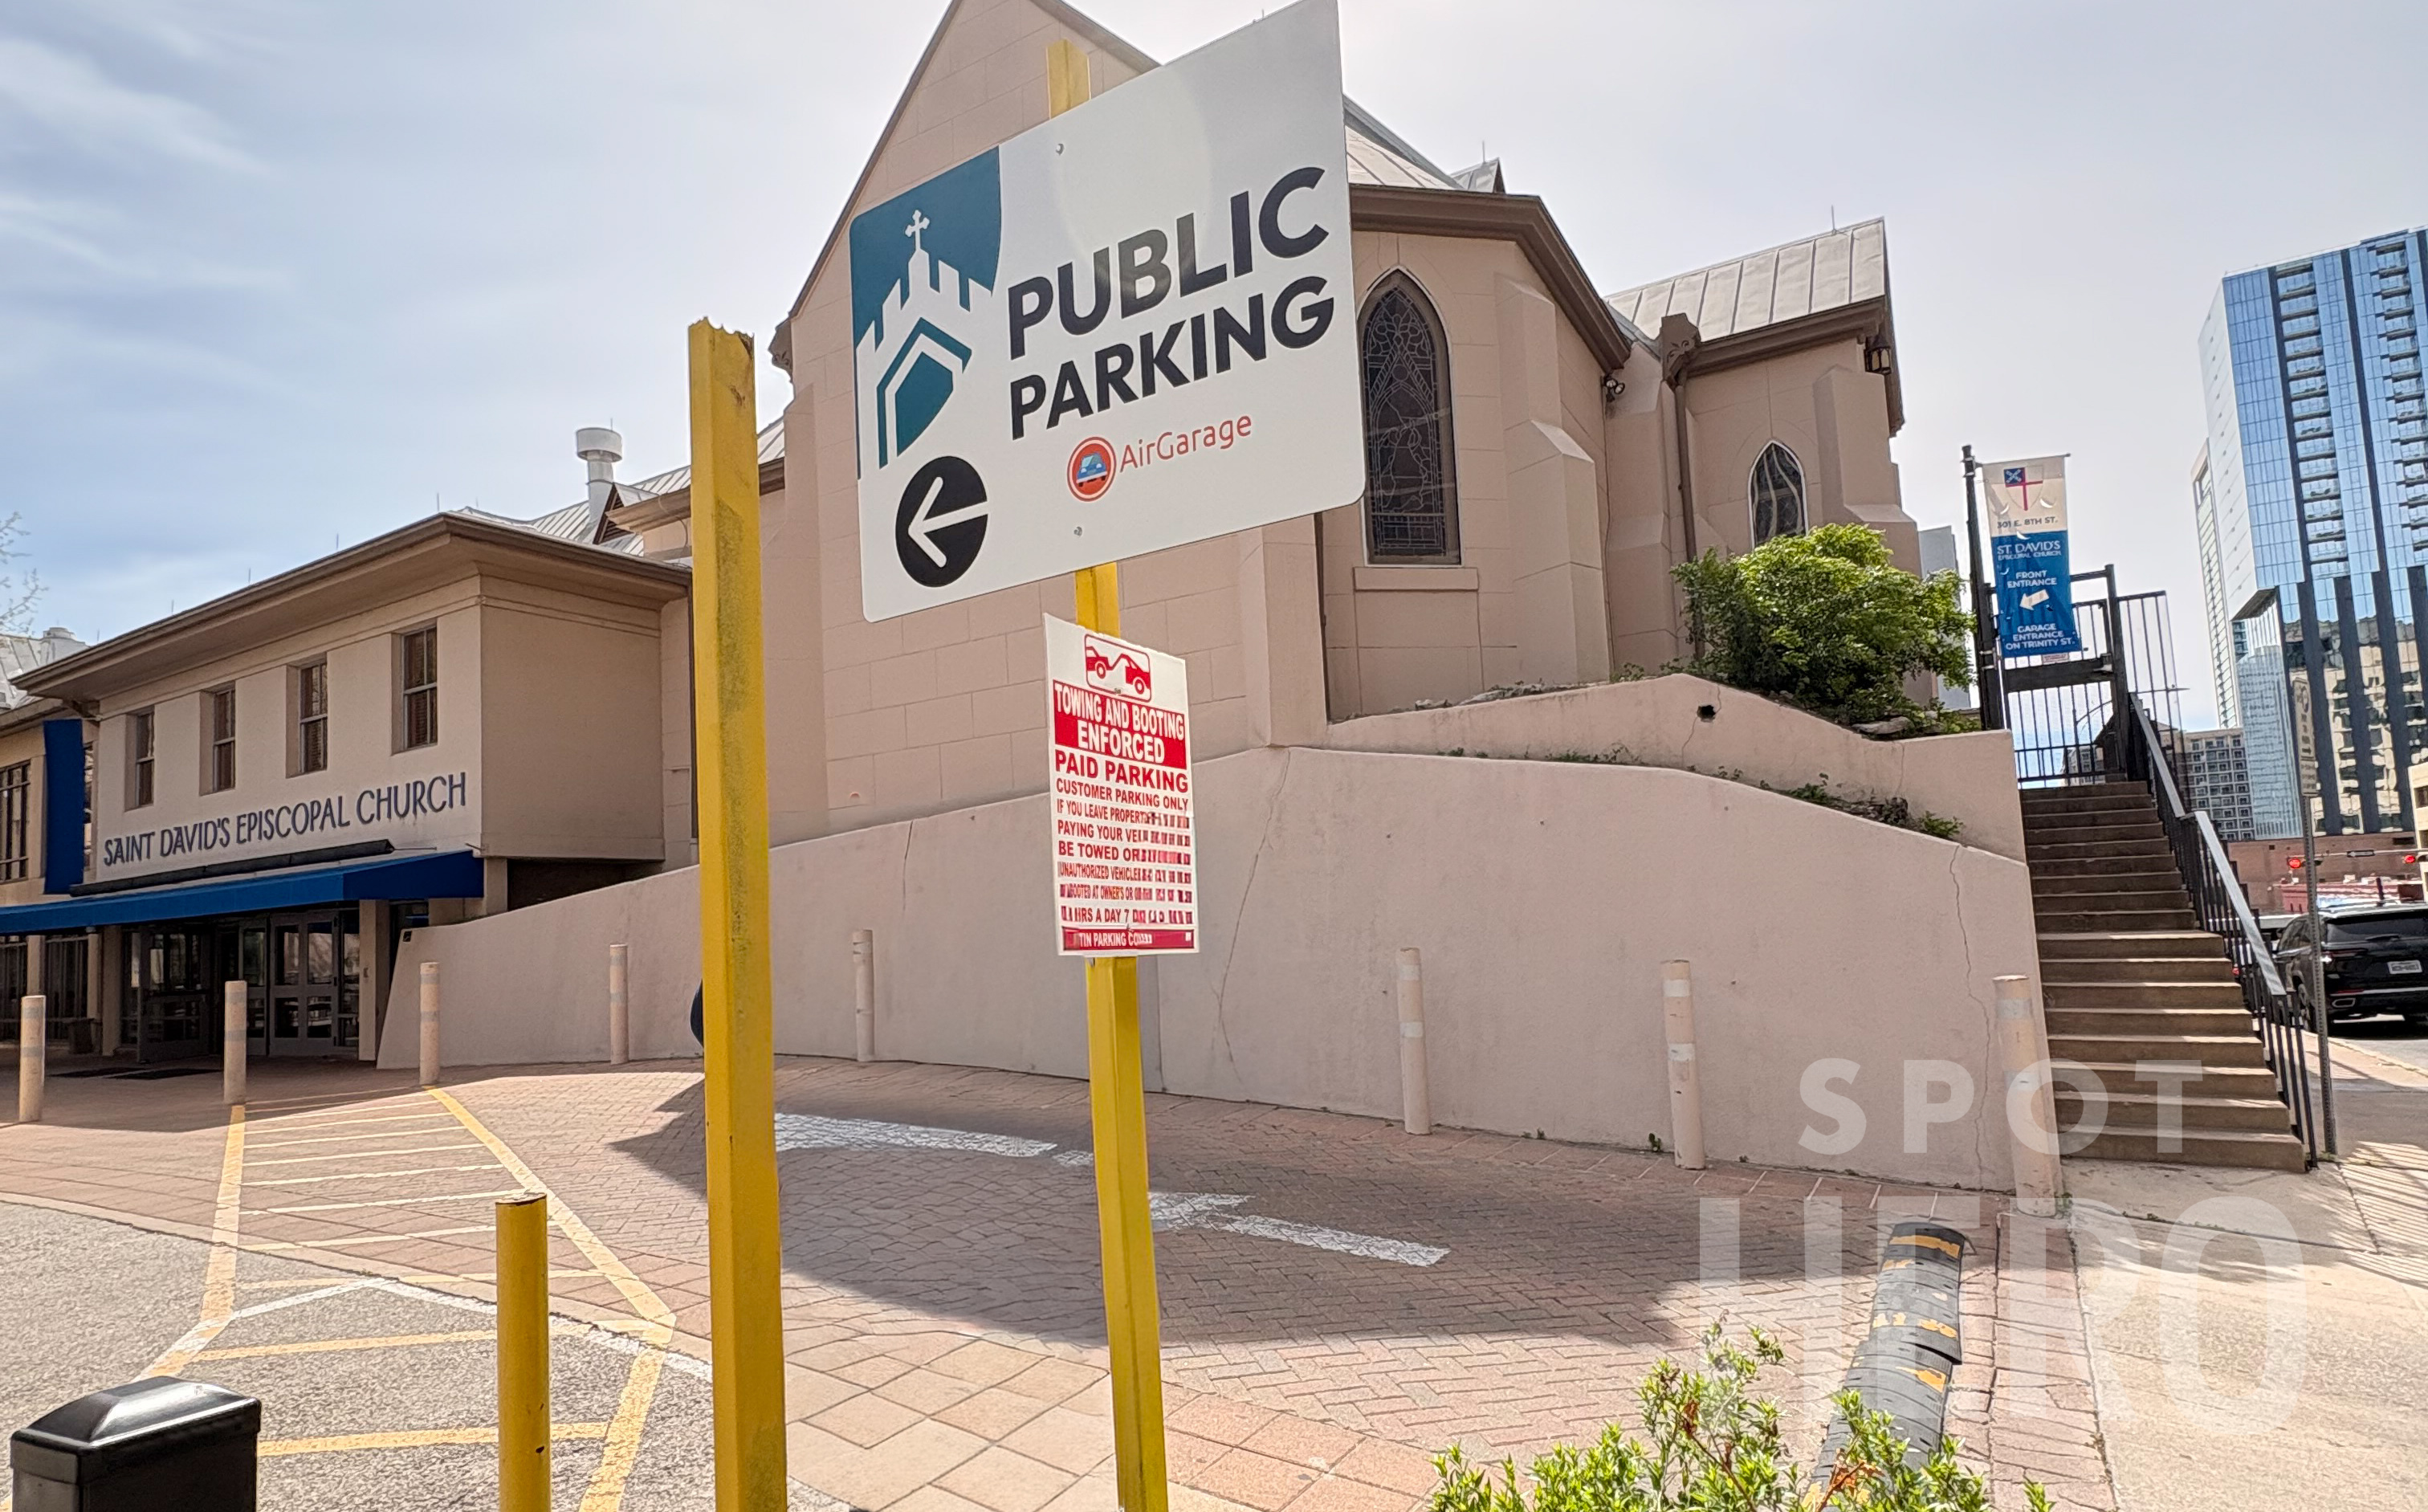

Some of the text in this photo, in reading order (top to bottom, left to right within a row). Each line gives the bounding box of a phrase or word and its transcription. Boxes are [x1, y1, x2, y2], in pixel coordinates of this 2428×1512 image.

[1008, 166, 1330, 361] PUBLIC
[1010, 275, 1335, 441] PARKING
[1119, 415, 1252, 473] AirGarage
[1997, 520, 2011, 528] 301
[2024, 517, 2042, 525] 8TH
[1997, 540, 2061, 555] ST. DAVID'S
[2033, 550, 2061, 558] CHURCH
[2007, 577, 2057, 589] ENTRANCE
[2015, 569, 2047, 579] FRONT
[2012, 630, 2064, 642] ENTRANCE
[2017, 623, 2056, 633] GARAGE
[2005, 637, 2076, 650] ON TRINITY ST.
[1054, 683, 1184, 741] TOWING AND BOOTING
[1077, 719, 1165, 764] ENFORCED
[1055, 748, 1188, 793] PAID PARKING
[1056, 777, 1189, 812] CUSTOMER PARKING ONLY
[103, 771, 466, 866] SAINT DAVID'S EPISCOPAL CHURCH
[1057, 798, 1065, 814] IF
[1066, 800, 1082, 817] YOU
[1085, 804, 1108, 821] LEAVE
[1057, 819, 1094, 838] PAYING
[1097, 824, 1123, 842] YOUR
[1058, 840, 1074, 857] BE
[1077, 843, 1119, 861] TOWED
[1057, 862, 1109, 880] UNAUTHORIZED
[1095, 908, 1102, 923] A
[1104, 908, 1121, 923] DAY
[1124, 909, 1130, 923] 7
[1093, 932, 1126, 947] PARKING
